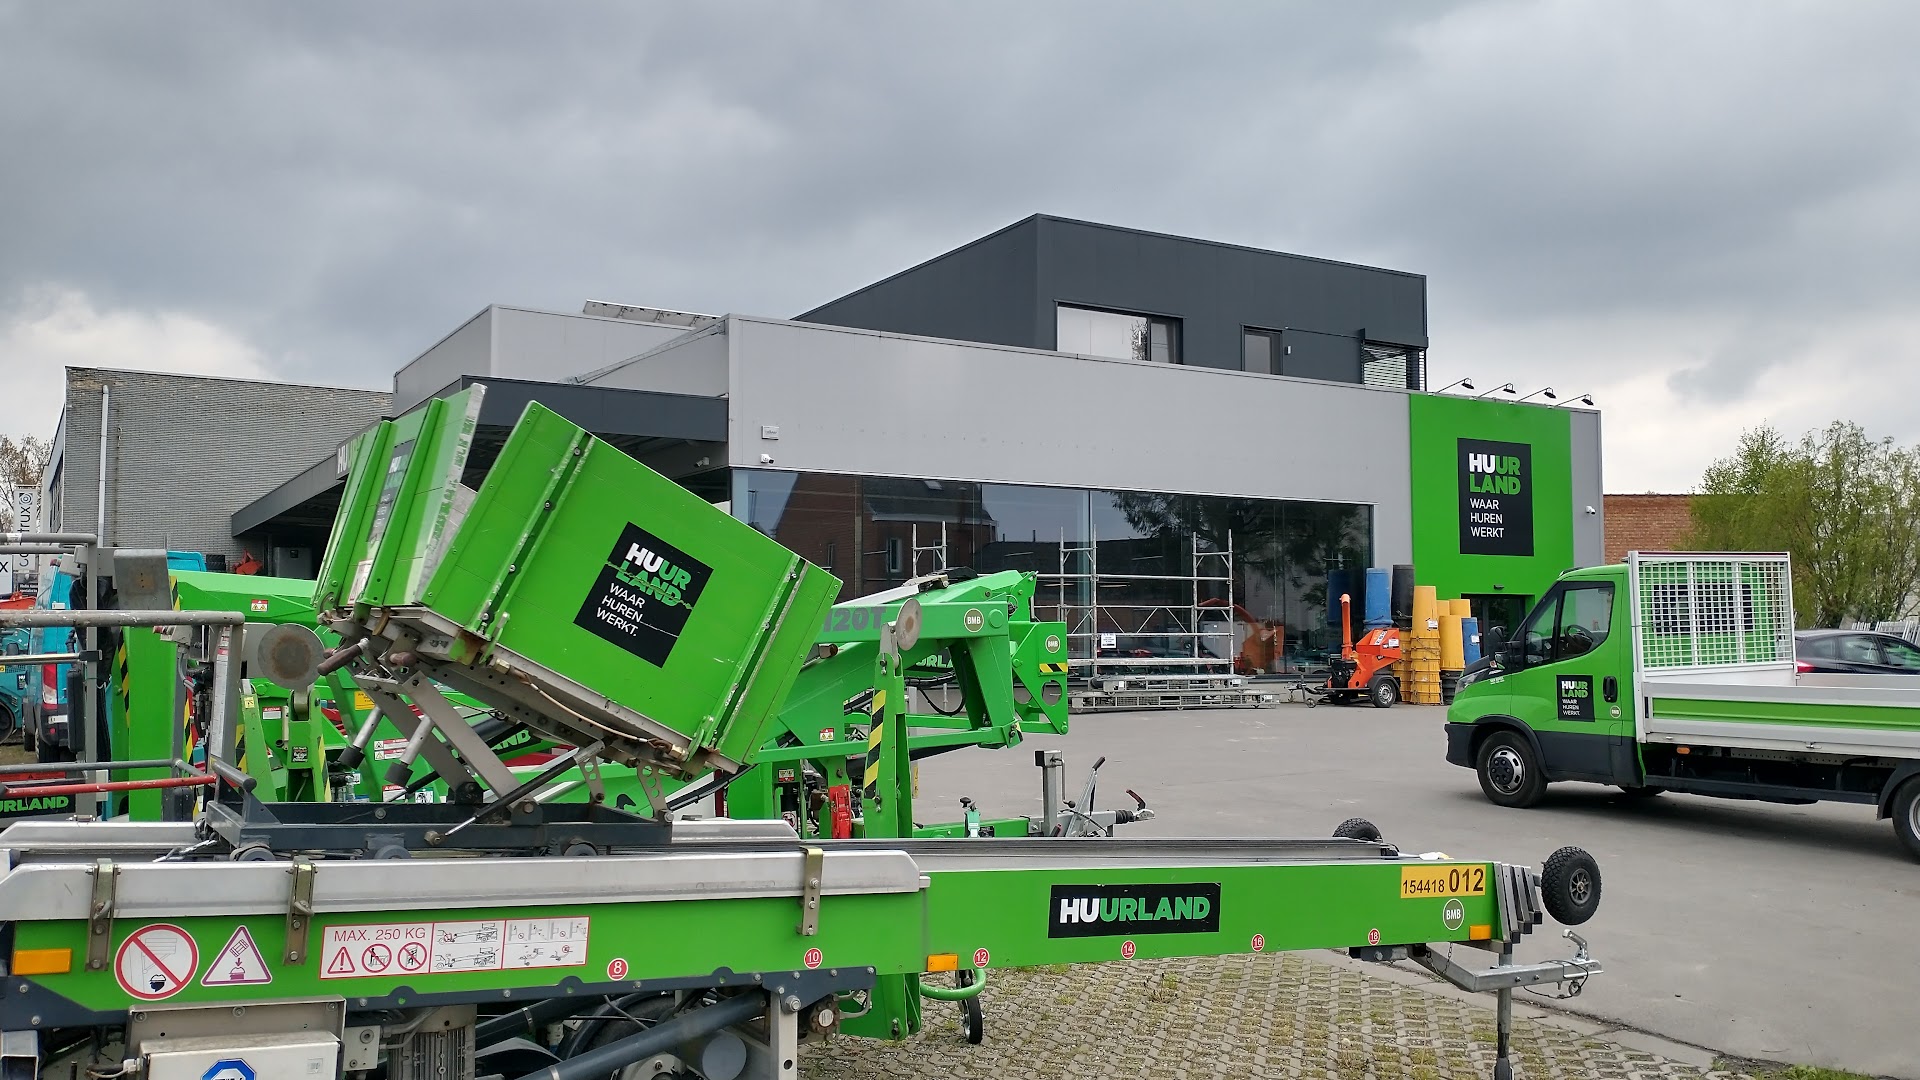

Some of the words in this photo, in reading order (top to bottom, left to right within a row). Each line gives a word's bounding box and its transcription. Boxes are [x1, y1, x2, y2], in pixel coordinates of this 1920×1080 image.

[1468, 452, 1521, 476] HUUR
[1469, 473, 1521, 495] LAND
[1470, 498, 1499, 510] WAAR
[1470, 513, 1503, 524] HUREN
[1470, 526, 1505, 538] WERKT
[625, 542, 692, 591] HUUR
[615, 560, 682, 607] LAND
[609, 582, 646, 609] WAAR
[601, 595, 643, 623] HUREN
[596, 607, 639, 637] WERKT.
[966, 616, 981, 625] BMB
[1047, 640, 1059, 648] BMB
[1561, 680, 1588, 690] HUUR
[1562, 689, 1589, 698] LAND
[0, 796, 69, 813] RLAND
[1402, 879, 1445, 894] 154418
[1448, 867, 1484, 893] 012
[1059, 896, 1211, 924] HUURLAND
[1446, 908, 1461, 920] BMB
[334, 929, 371, 942] MAX.
[375, 928, 400, 940] 250
[405, 927, 426, 939] KG
[1370, 931, 1378, 940] 18
[1253, 937, 1263, 947] 16
[1123, 944, 1134, 954] 14
[807, 951, 819, 963] 10
[976, 951, 987, 962] 12
[613, 961, 622, 974] 8
